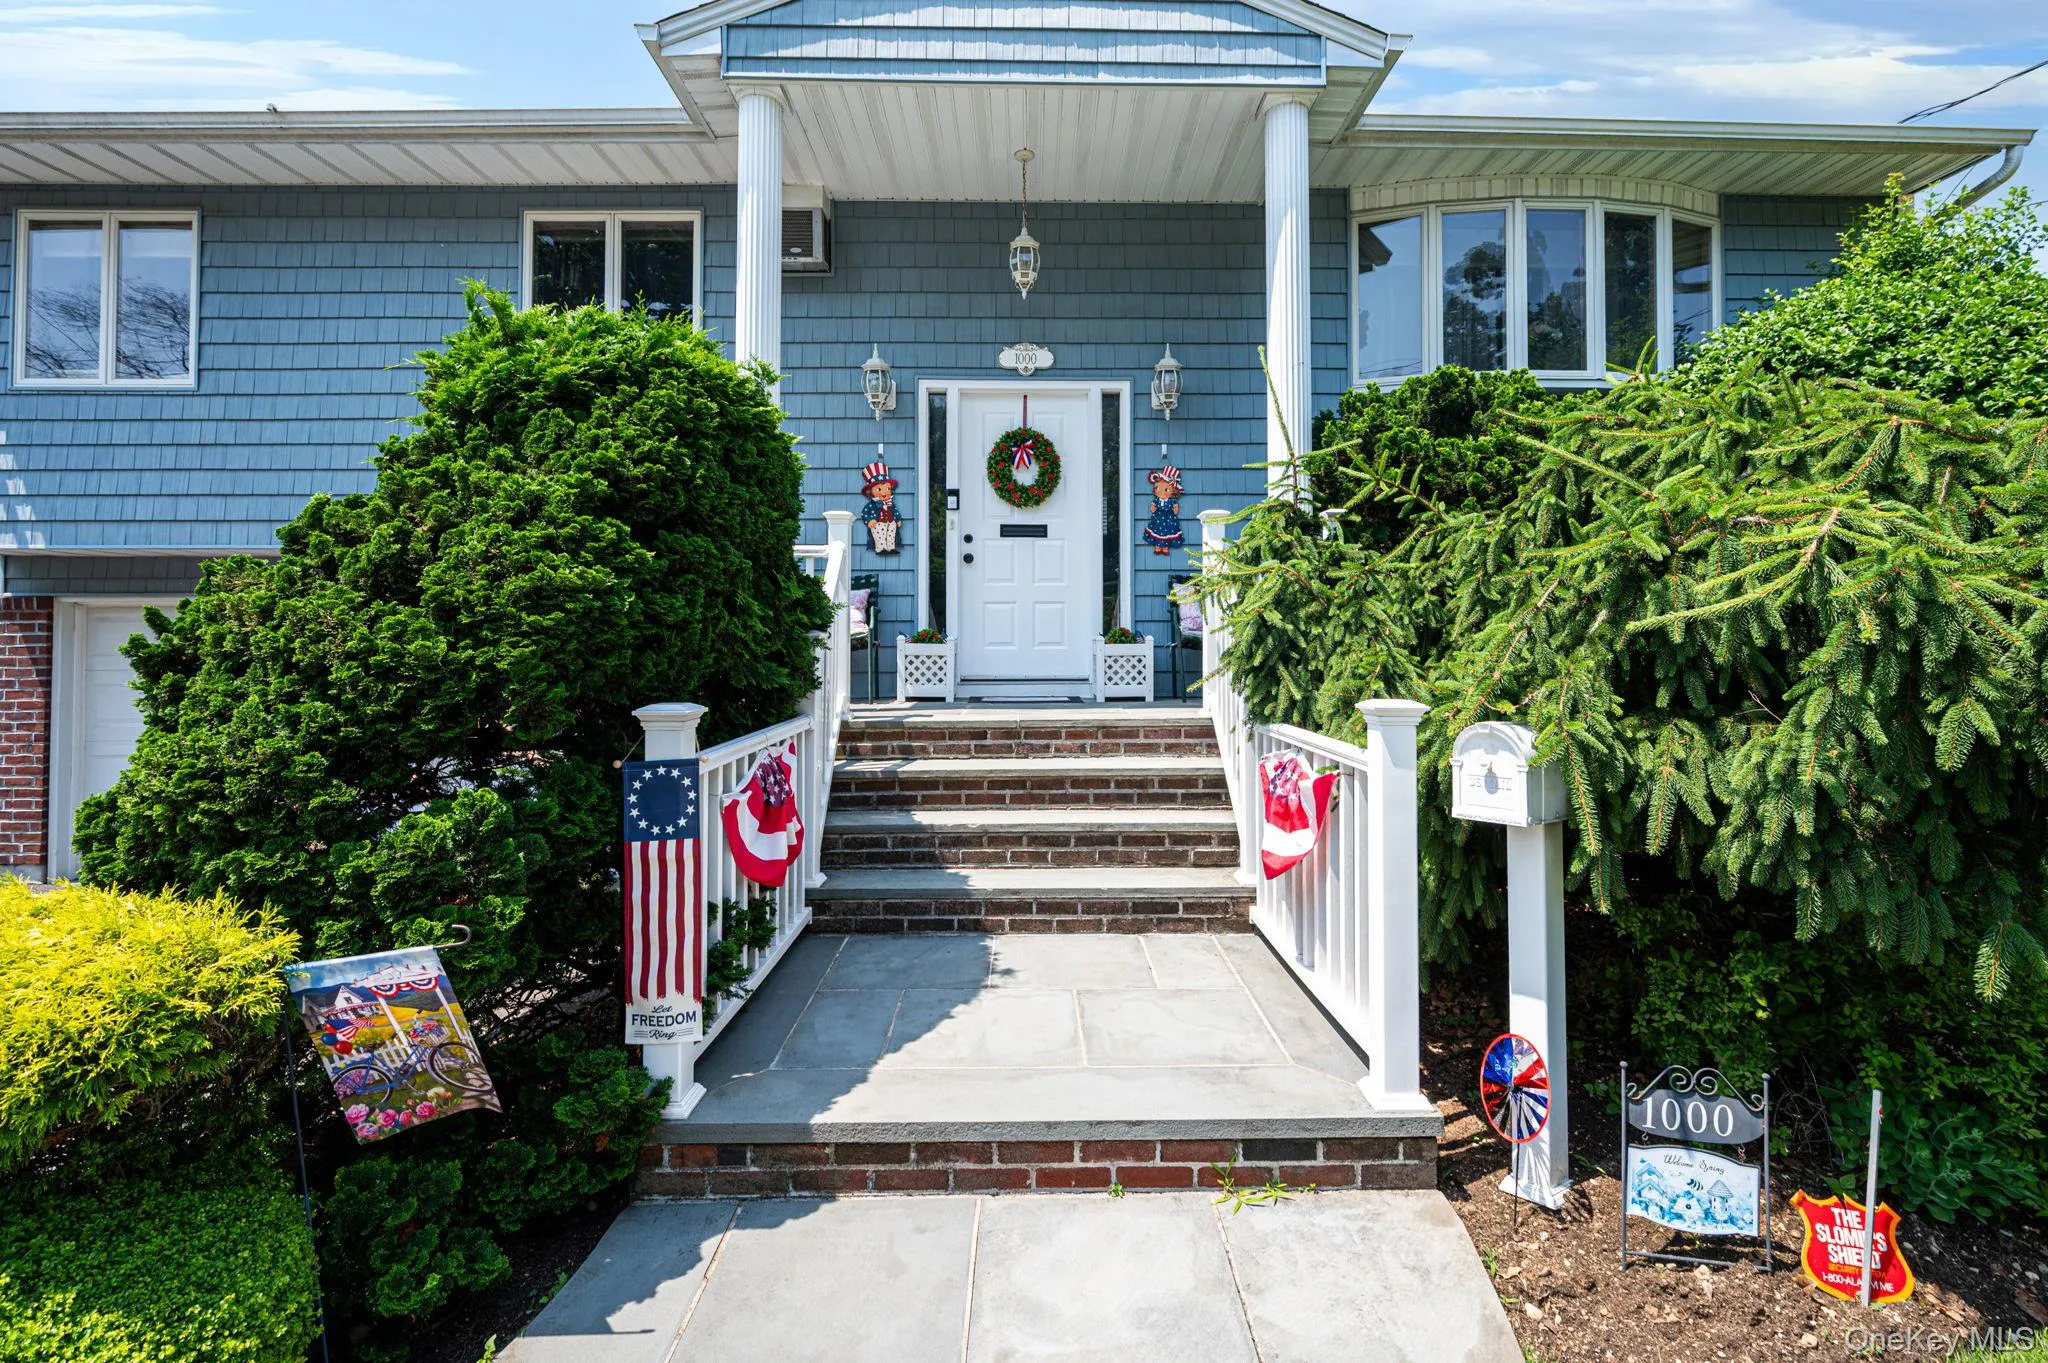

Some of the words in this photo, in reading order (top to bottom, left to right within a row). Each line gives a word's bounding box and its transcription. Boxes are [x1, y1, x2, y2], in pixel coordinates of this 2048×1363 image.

[1015, 352, 1037, 365] 1000
[631, 1010, 697, 1027] FREEDOM
[651, 1004, 673, 1014] Let
[648, 1029, 678, 1040] Ring
[1642, 1096, 1734, 1137] 1000
[1663, 1153, 1694, 1169] Welcome
[1699, 1159, 1725, 1175] Spring
[1831, 1207, 1864, 1230] THE
[1815, 1222, 1888, 1252] SLOMI'S
[1827, 1244, 1882, 1270] SHIED
[1821, 1271, 1879, 1290] 1-800-ALAM
